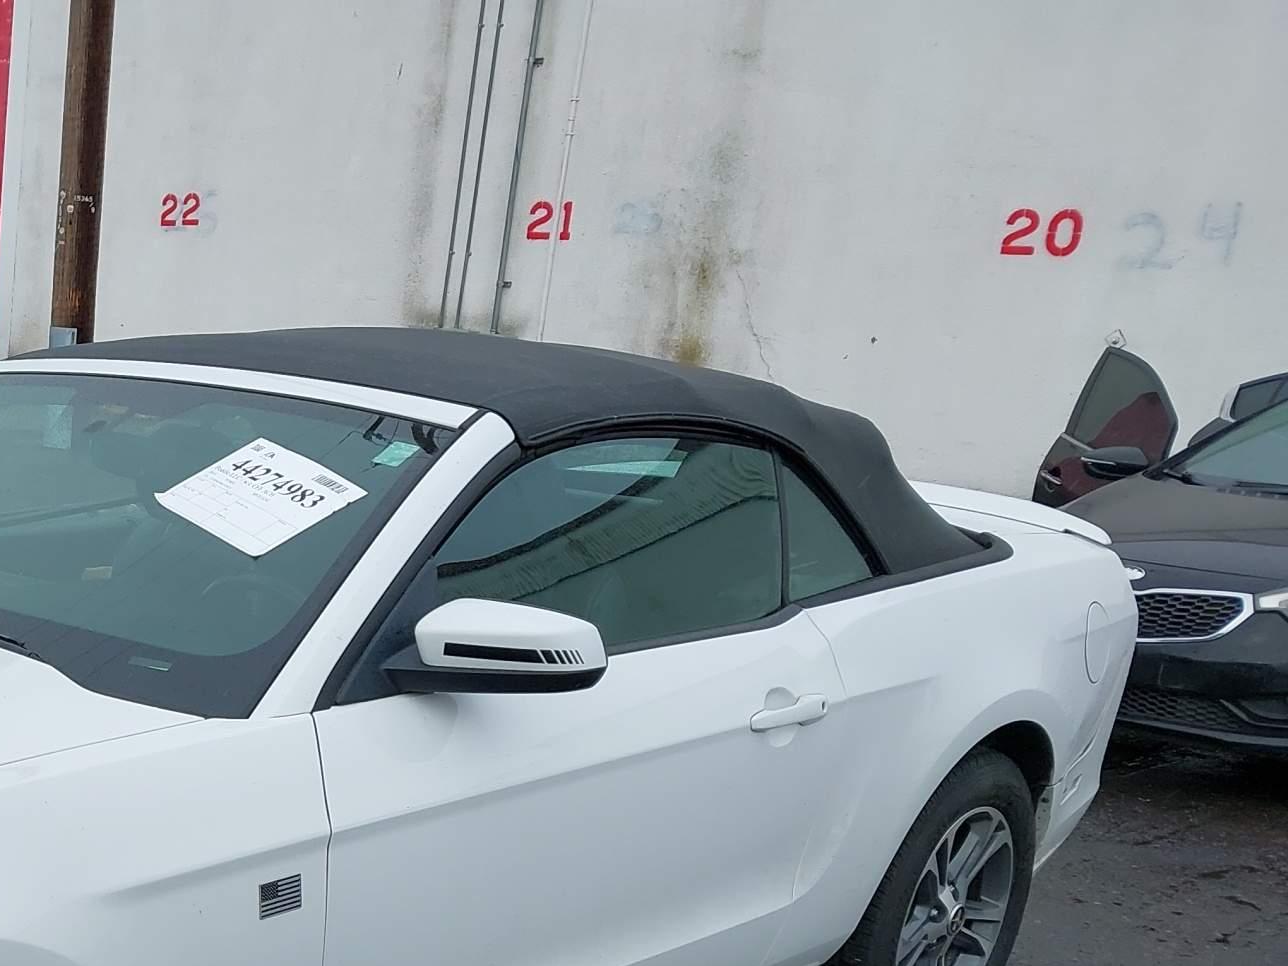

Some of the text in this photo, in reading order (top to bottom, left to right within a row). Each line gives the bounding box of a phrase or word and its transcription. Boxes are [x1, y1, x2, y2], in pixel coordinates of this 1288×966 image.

[160, 193, 201, 226] 22
[526, 201, 573, 240] 21
[1000, 208, 1084, 257] 20
[231, 459, 326, 509] 44274983
